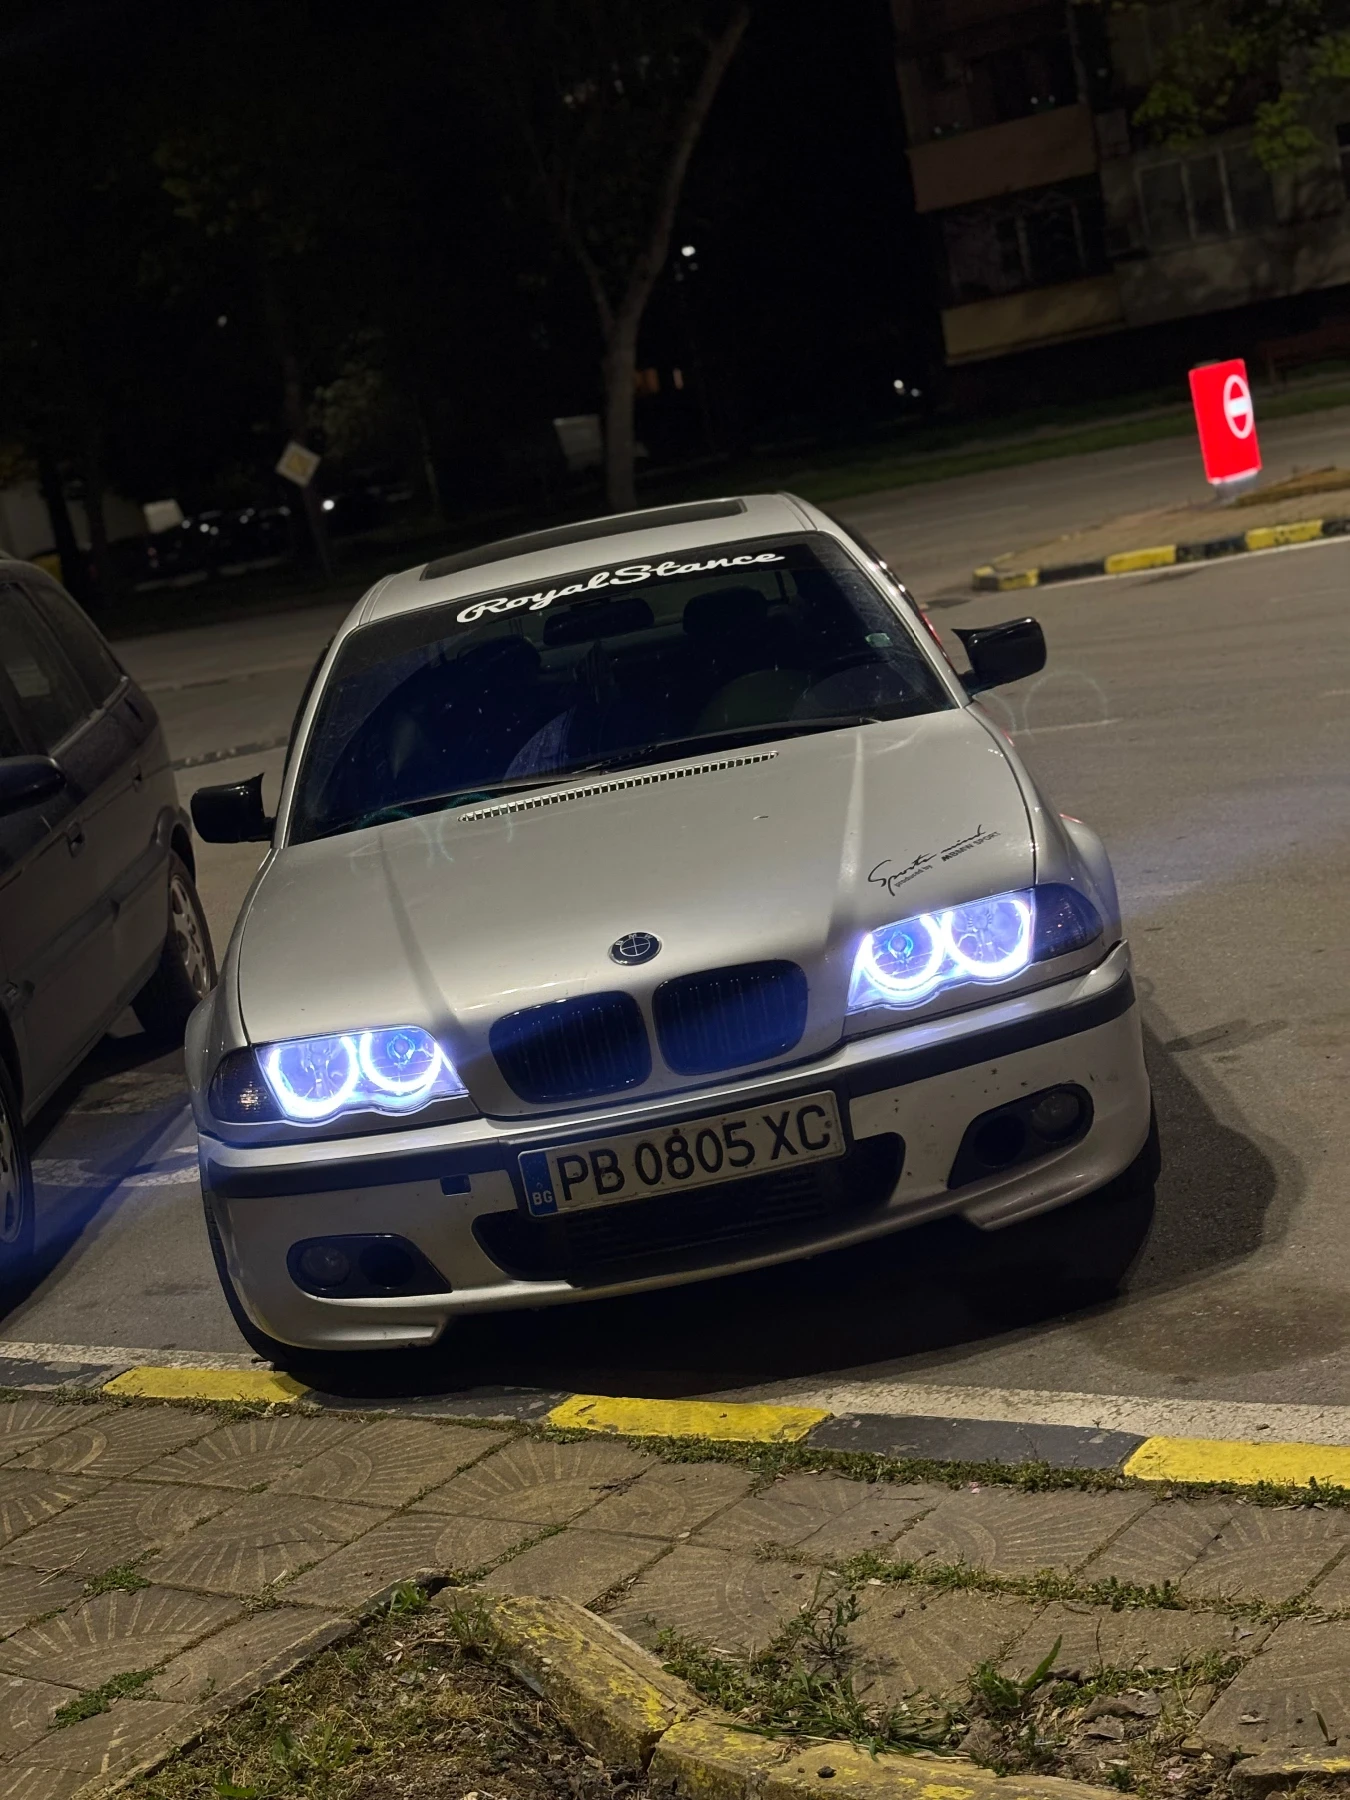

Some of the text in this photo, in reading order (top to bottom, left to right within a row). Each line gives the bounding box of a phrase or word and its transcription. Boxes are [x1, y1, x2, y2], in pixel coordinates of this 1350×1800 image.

[456, 552, 786, 623] RoyalStance
[615, 933, 653, 946] BMW
[556, 1104, 831, 1202] PB 0805 XC
[532, 1190, 553, 1206] BG
